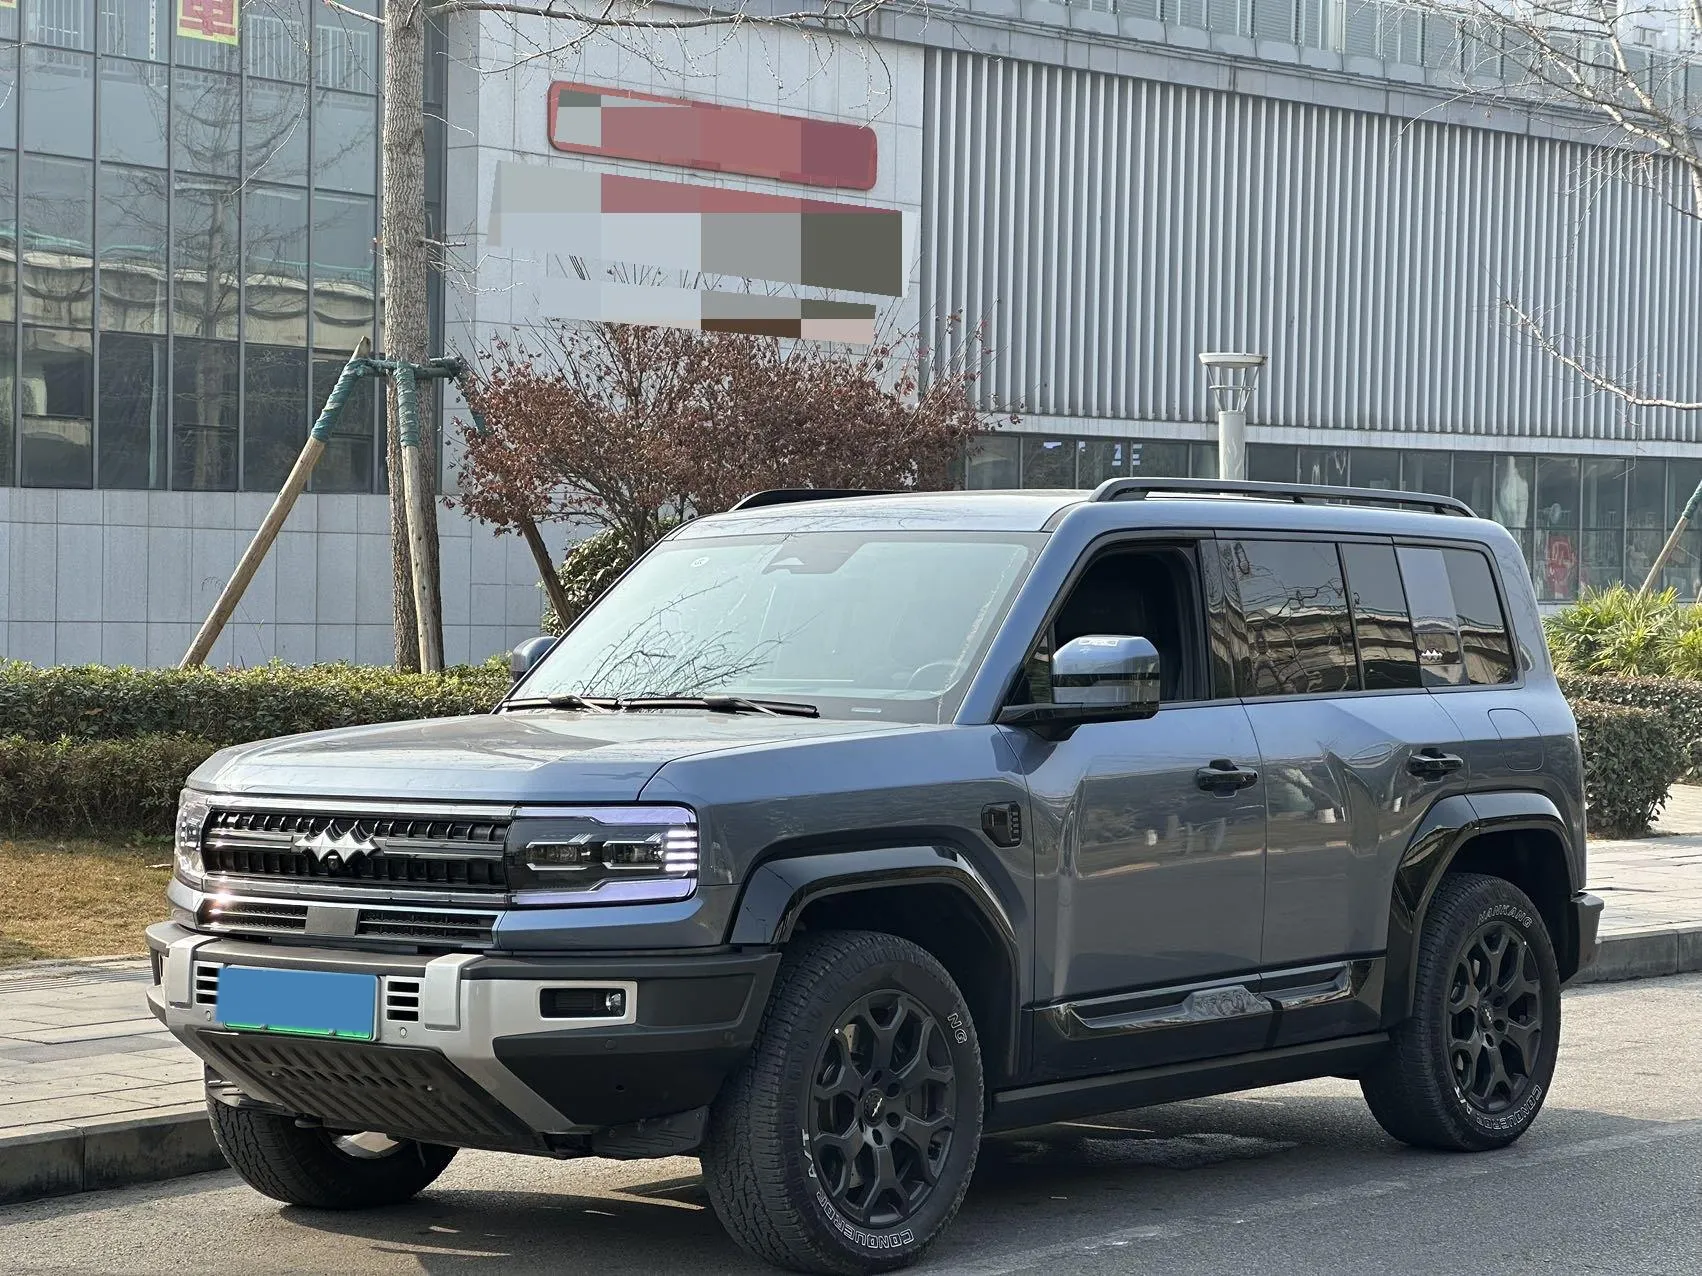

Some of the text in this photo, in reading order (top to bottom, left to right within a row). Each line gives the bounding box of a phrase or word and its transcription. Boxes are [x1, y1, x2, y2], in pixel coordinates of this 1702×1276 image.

[1477, 904, 1533, 929] NANKANG
[1475, 1084, 1542, 1130] CONQUEROR
[815, 1187, 914, 1249] CONQUEROR
